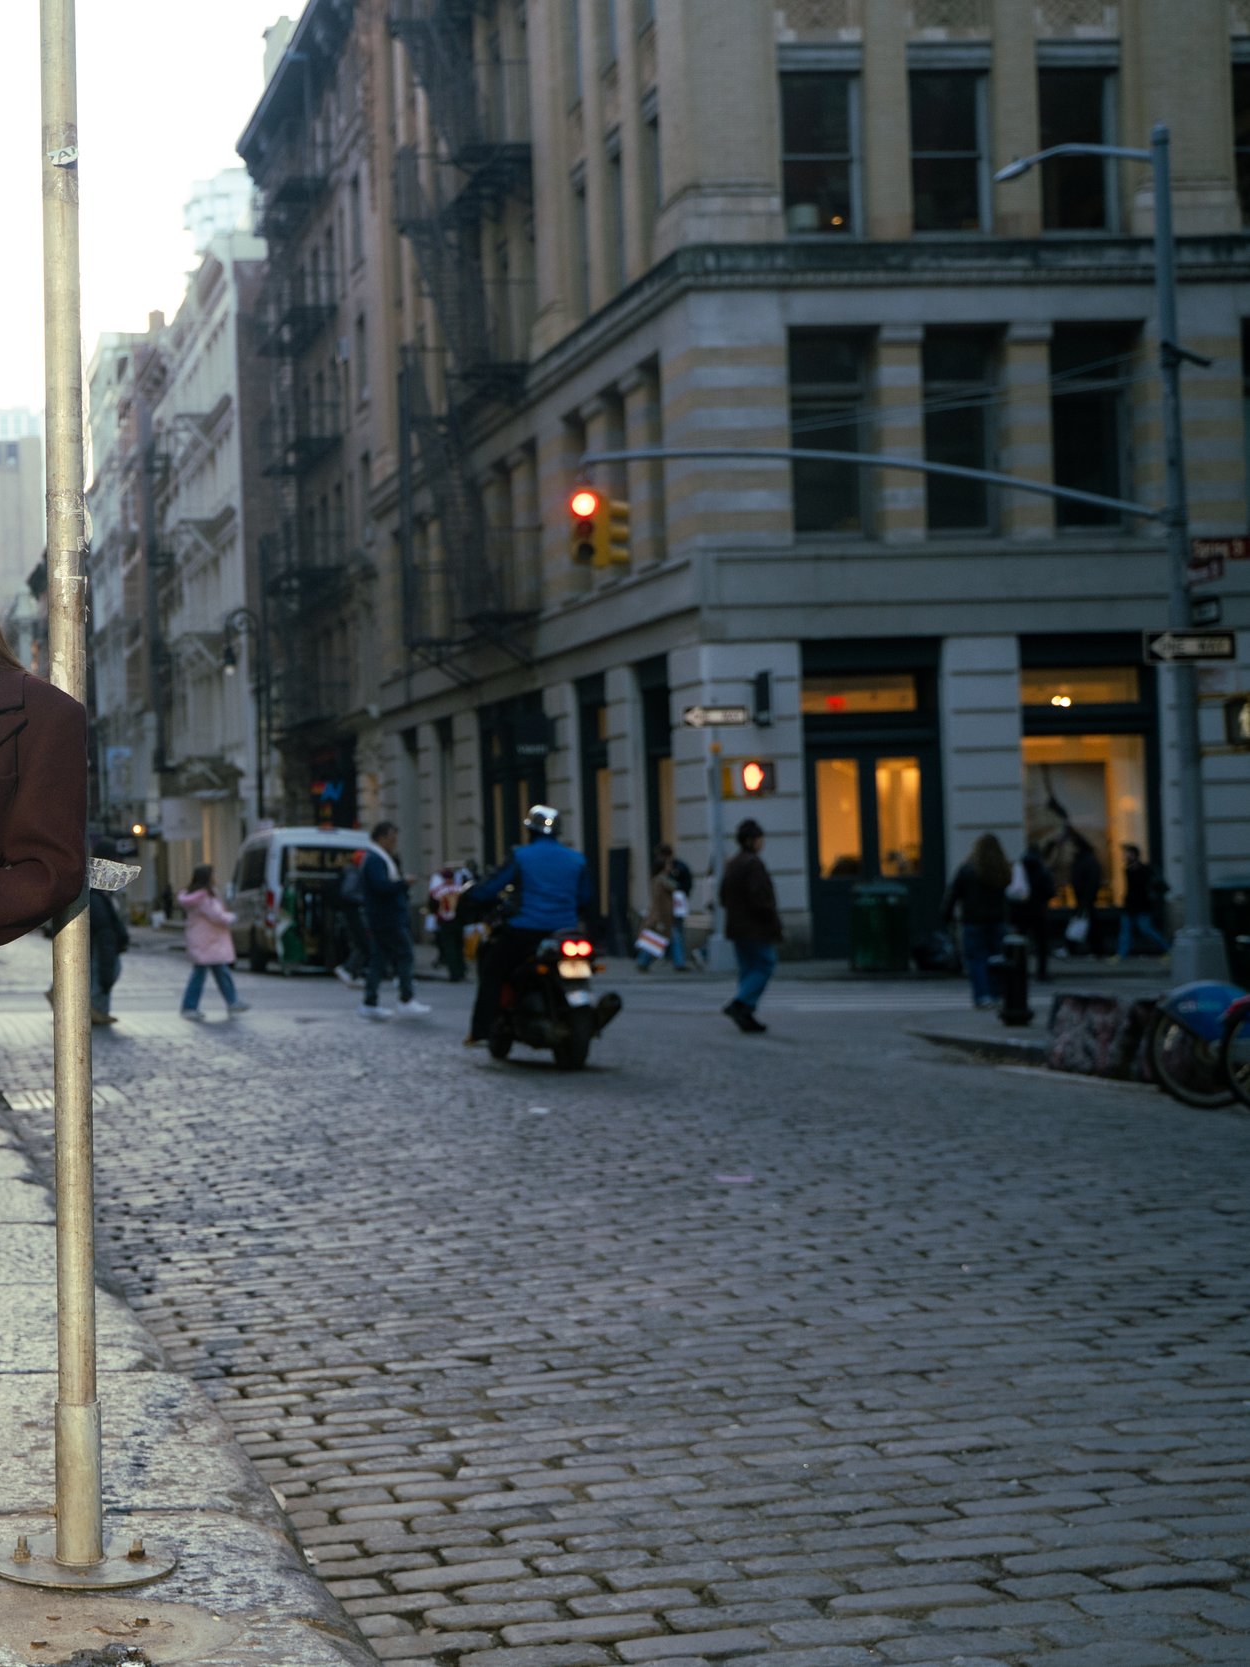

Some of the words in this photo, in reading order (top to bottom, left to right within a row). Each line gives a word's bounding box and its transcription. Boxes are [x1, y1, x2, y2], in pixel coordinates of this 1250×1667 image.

[1192, 541, 1229, 559] Spring
[1161, 638, 1185, 654] ONE
[1199, 638, 1225, 653] WAY
